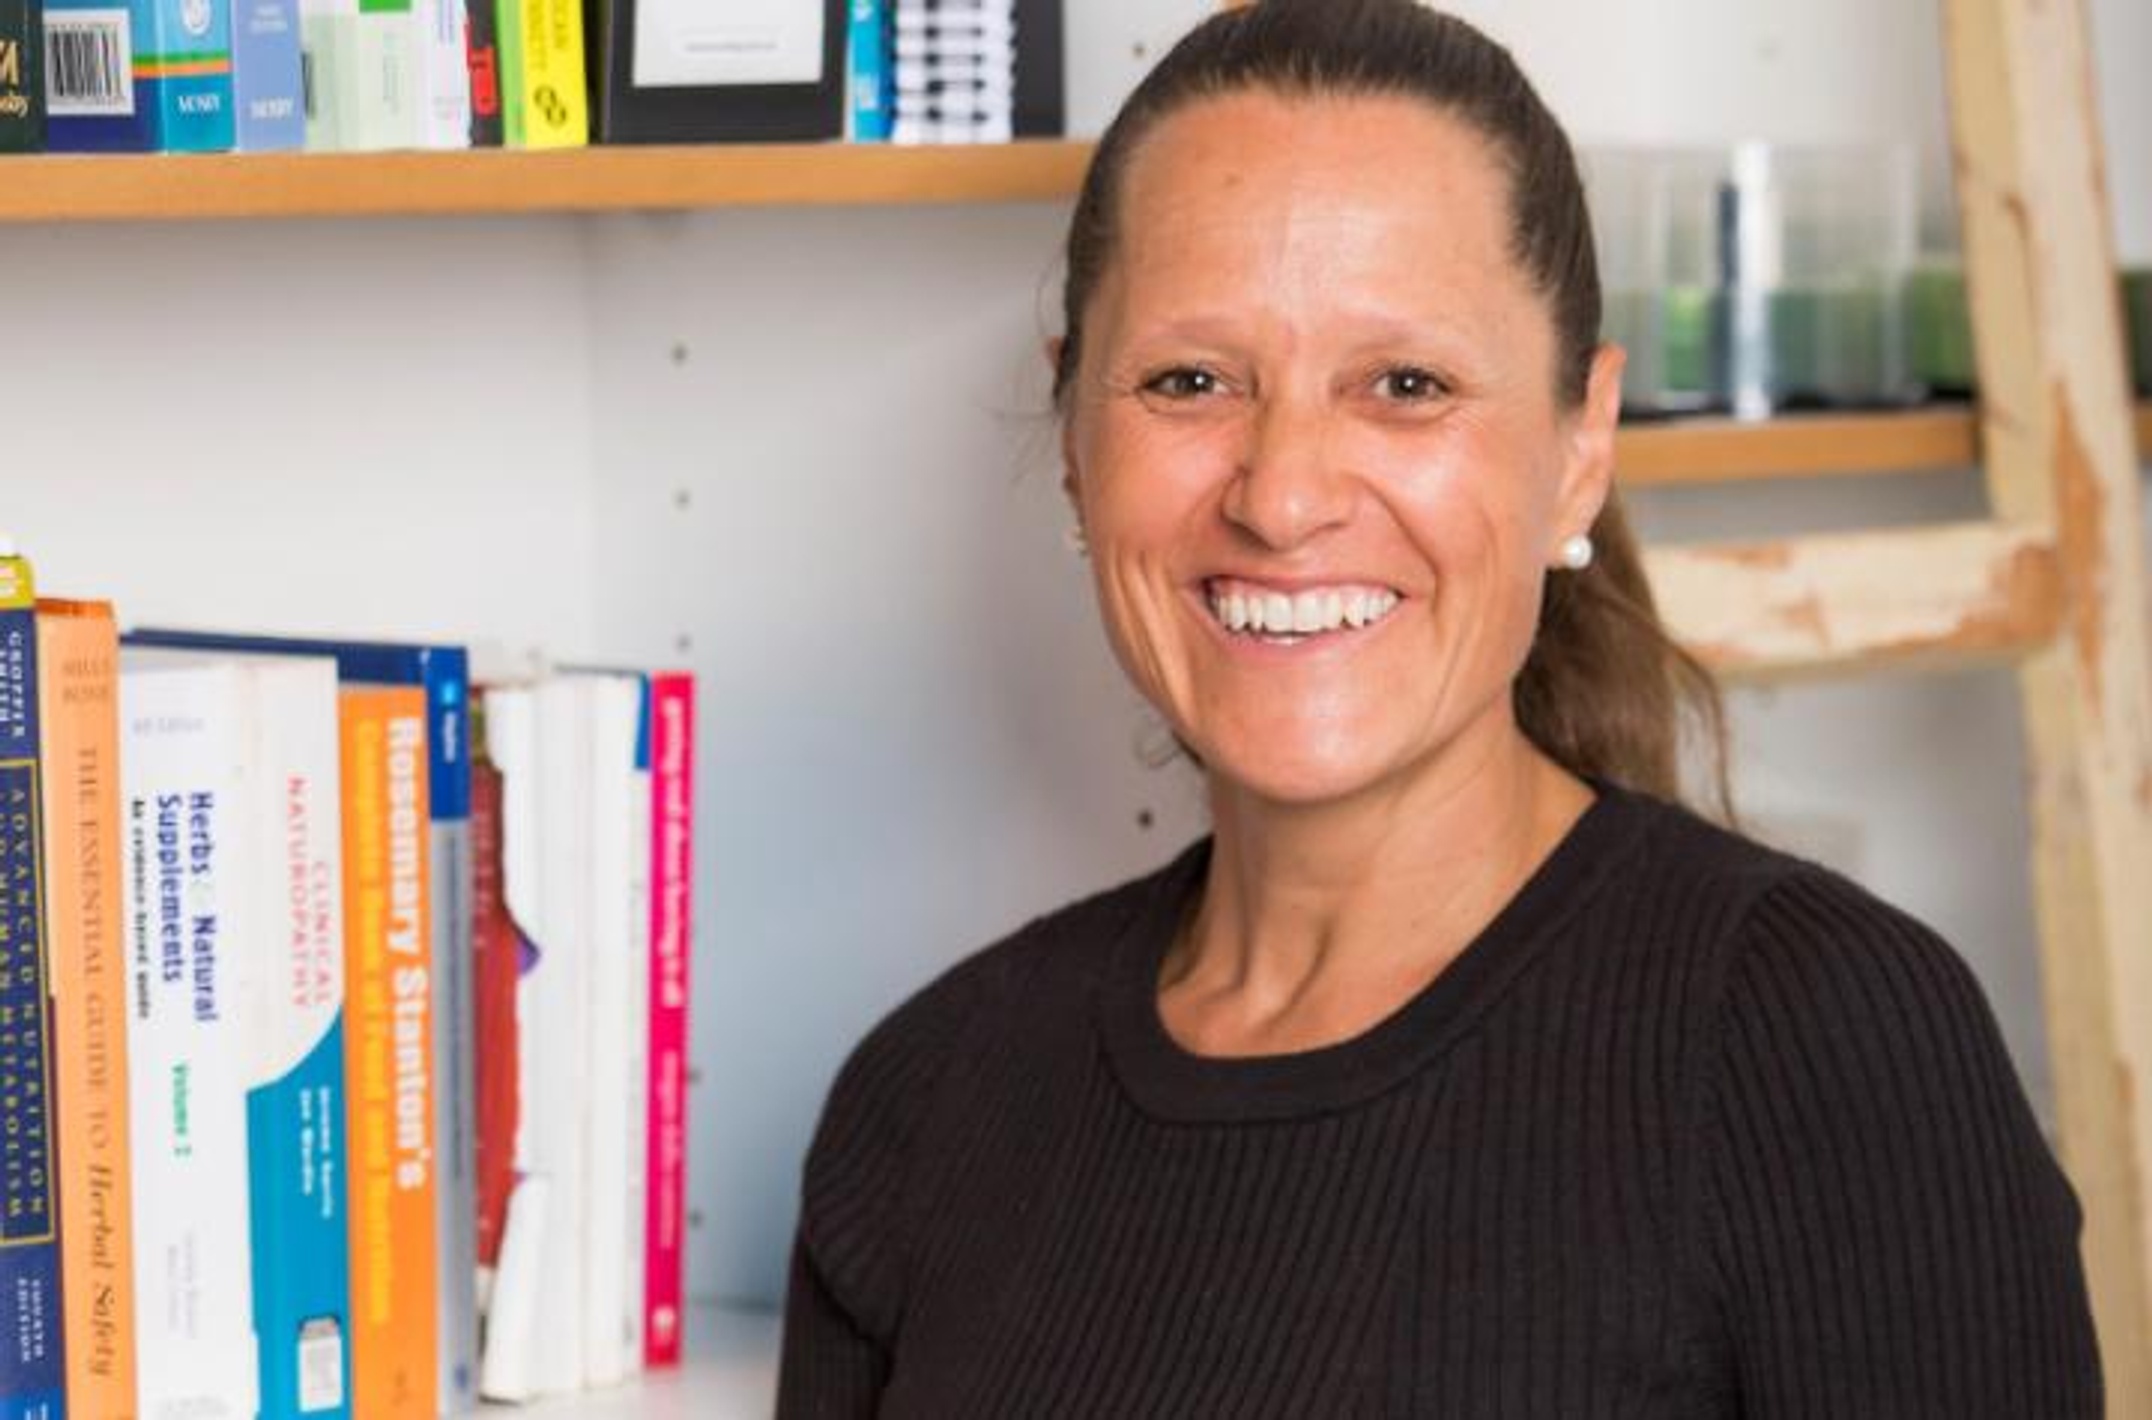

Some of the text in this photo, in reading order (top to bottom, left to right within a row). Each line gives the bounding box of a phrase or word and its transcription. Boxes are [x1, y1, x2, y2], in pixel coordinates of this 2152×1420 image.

[157, 793, 185, 983] Supplements
[190, 791, 214, 876] Herbs
[287, 777, 308, 1007] NATUROPATHY
[313, 860, 332, 1006] CLINICAL
[12, 788, 45, 1214] ADVANCED NUTRITION
[193, 915, 220, 1021] Natural
[387, 717, 432, 1189] Rosemary Stanton's
[0, 1006, 23, 1218] METABOLISM
[77, 746, 117, 1378] THE ESSENTIAL GUIDE TO Herbal Safety
